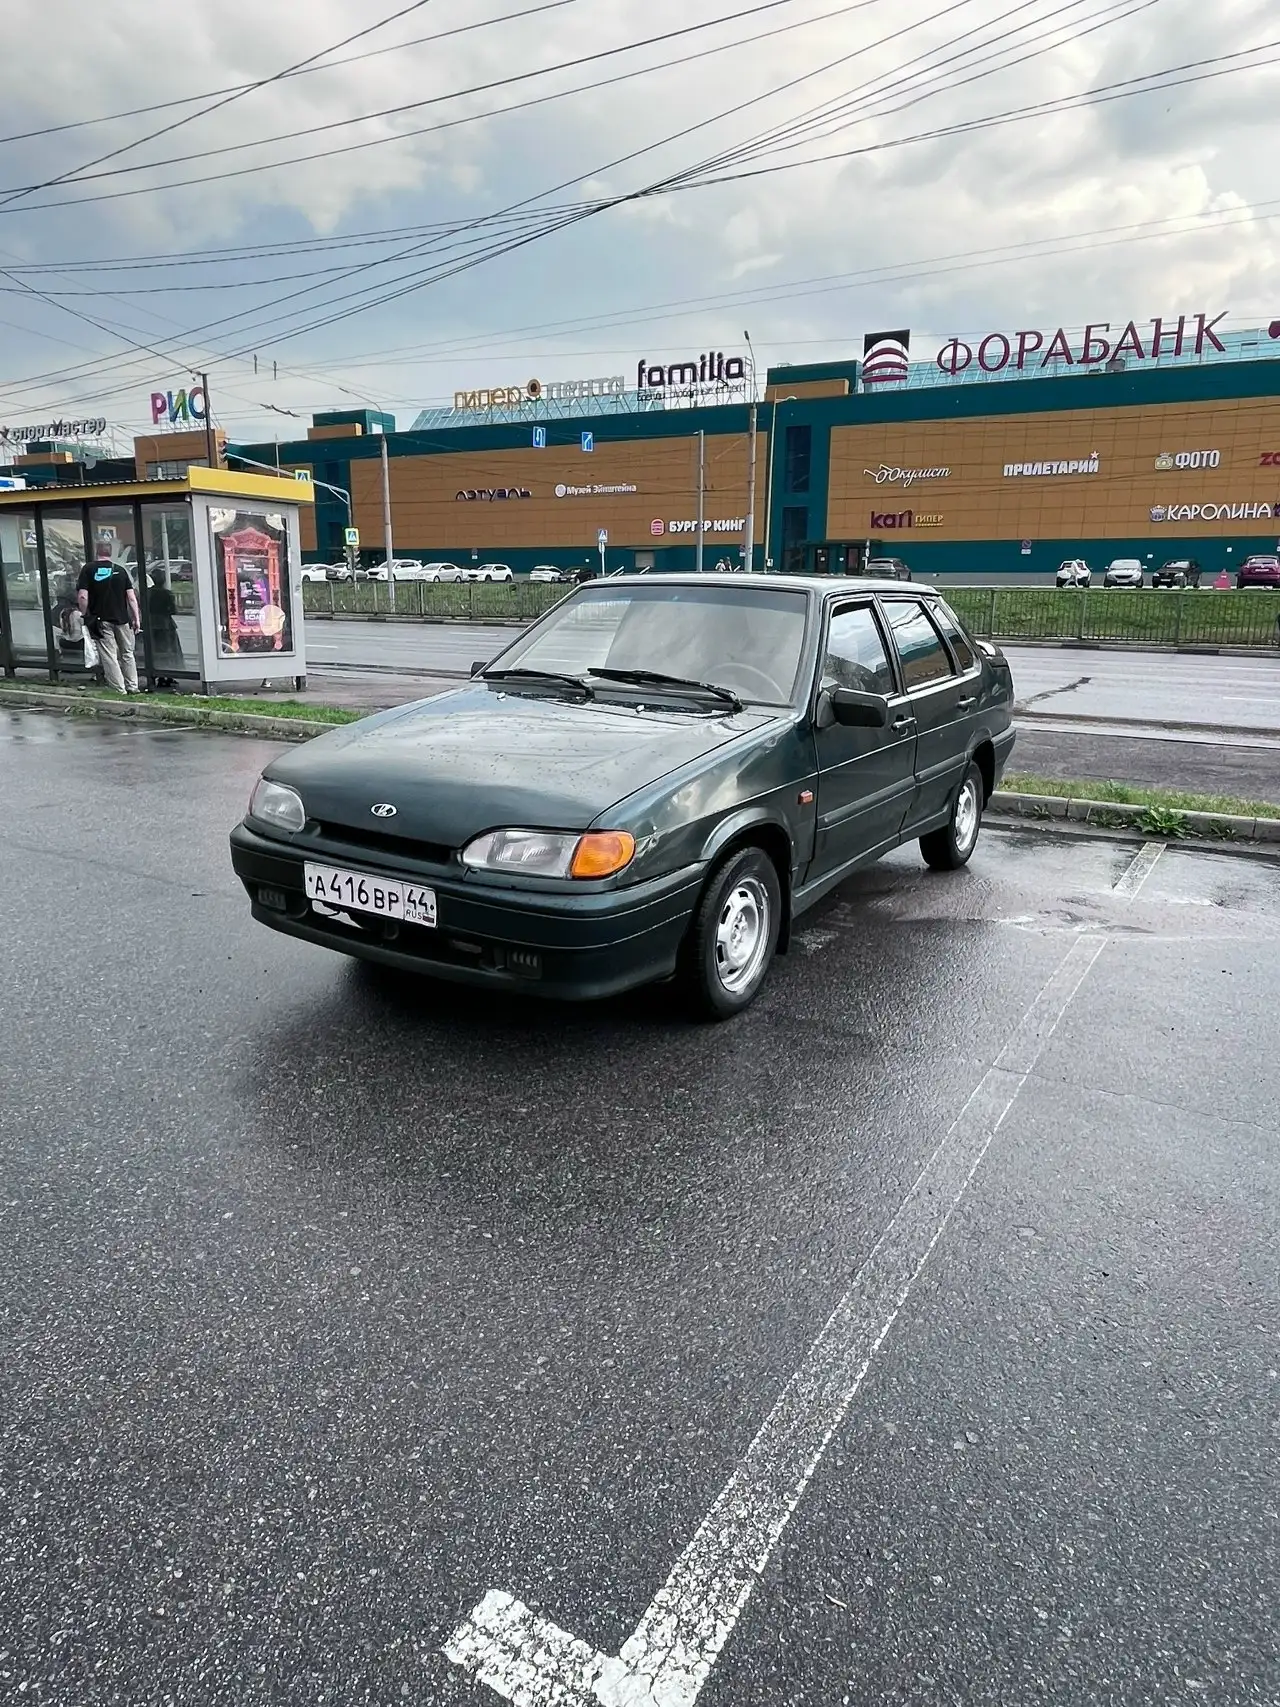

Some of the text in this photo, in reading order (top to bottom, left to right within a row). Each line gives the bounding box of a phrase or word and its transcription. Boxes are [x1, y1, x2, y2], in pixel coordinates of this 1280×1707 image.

[936, 311, 1229, 376] ФОРАБАНК
[638, 352, 744, 388] familia
[1003, 455, 1099, 477] ПРОЛЕТАРИЙ
[1175, 449, 1221, 469] ФОТО
[566, 482, 637, 495] Музей Эйнштейна
[915, 514, 944, 523] ГИПЕР
[1167, 503, 1272, 520] КАРОЛИНА
[713, 518, 746, 532] КИНГ
[407, 888, 429, 912] 44
[405, 909, 423, 920] RUS
